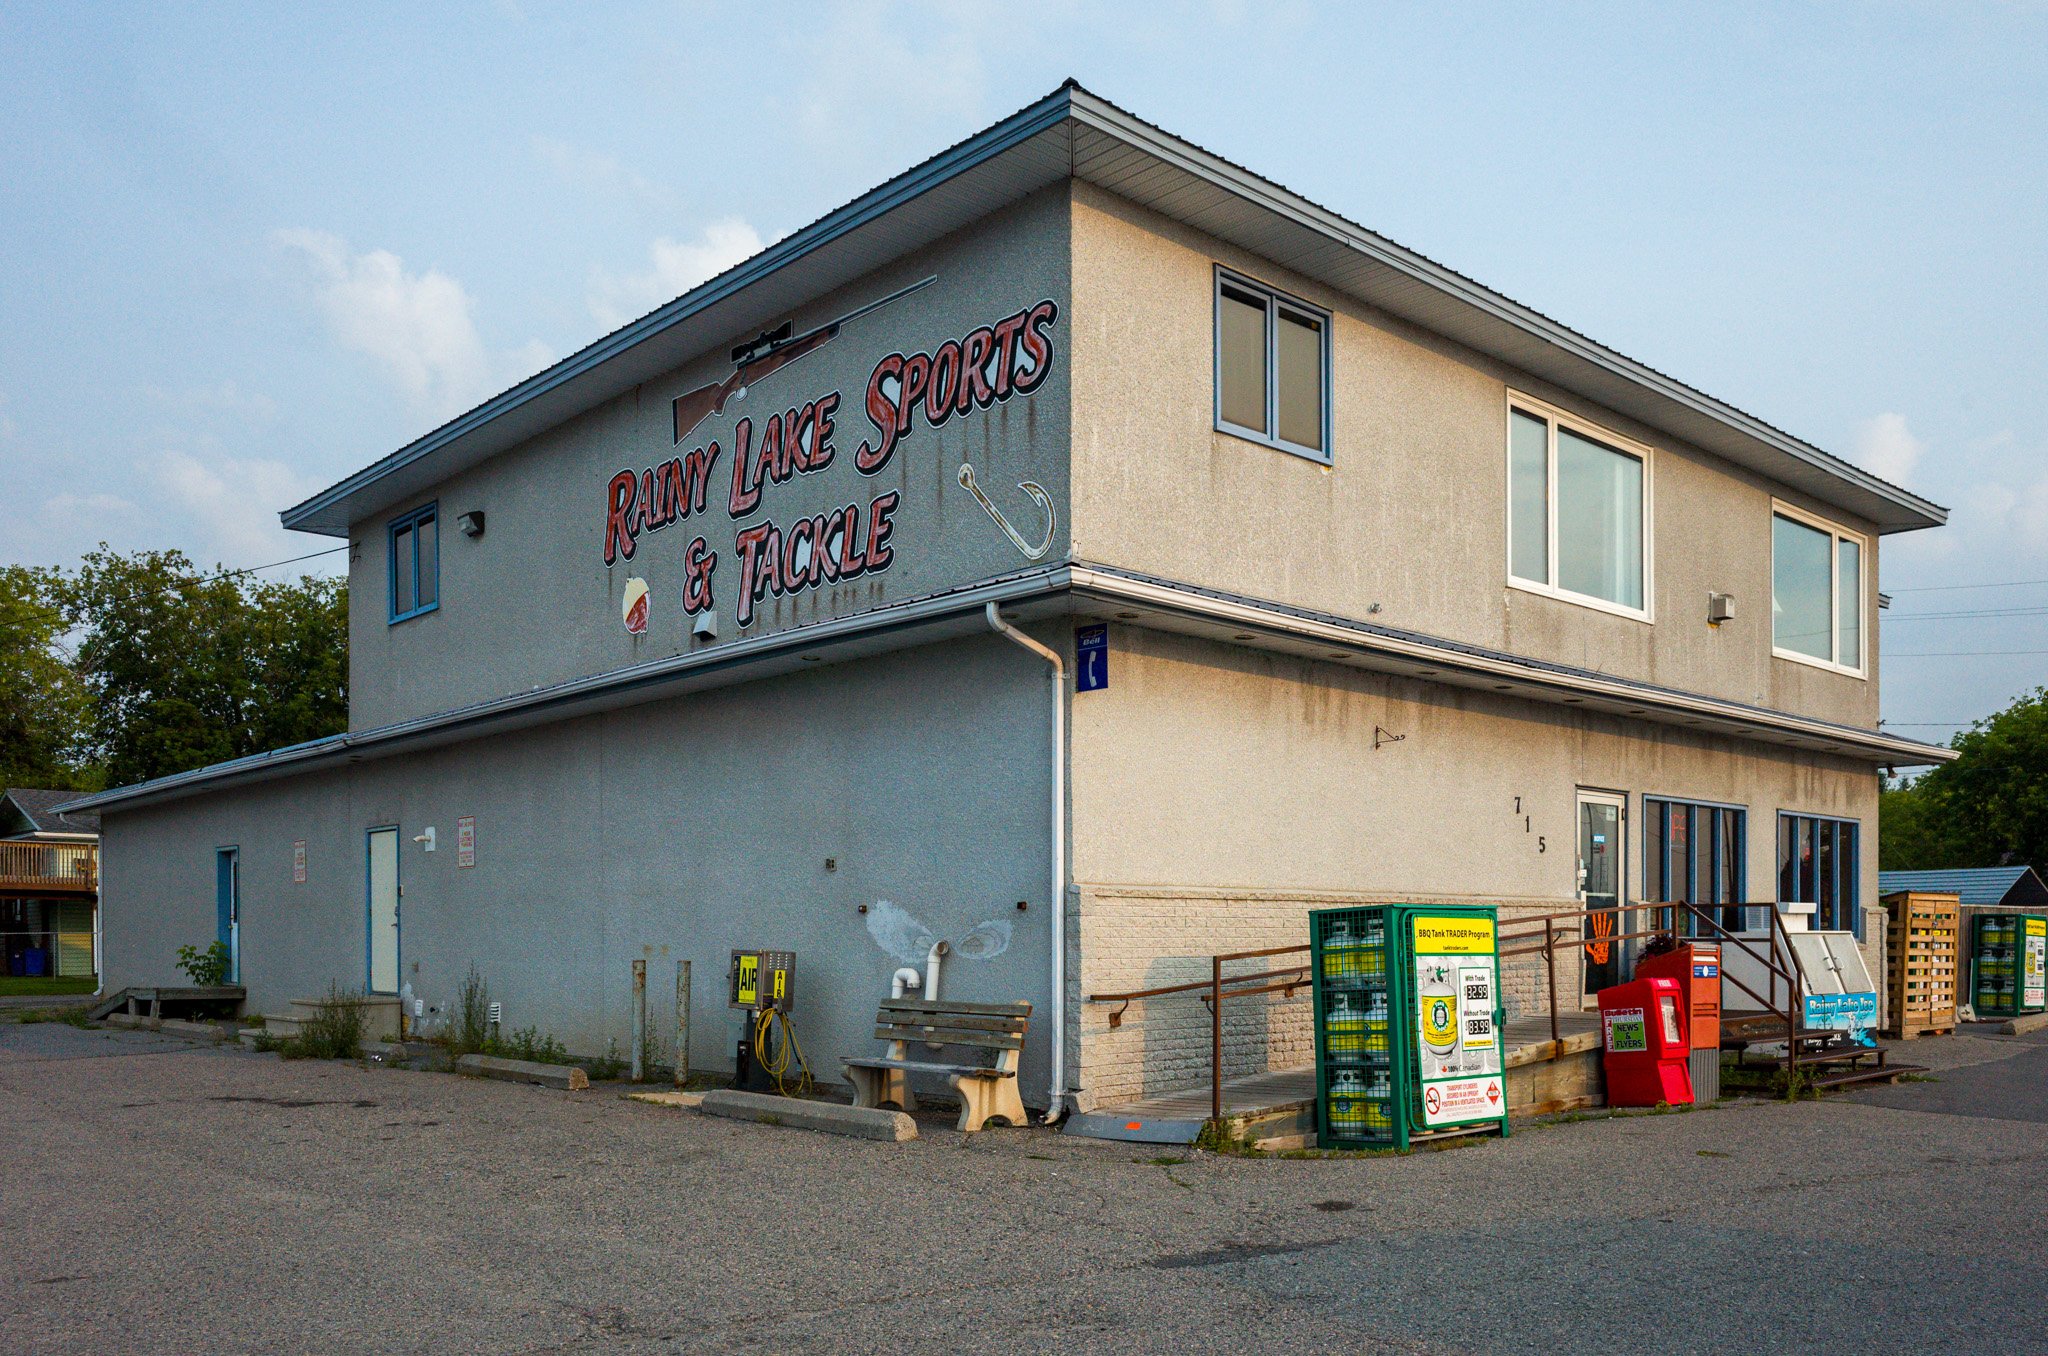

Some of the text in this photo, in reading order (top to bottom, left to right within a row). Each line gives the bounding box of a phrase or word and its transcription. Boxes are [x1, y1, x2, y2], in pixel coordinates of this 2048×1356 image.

[604, 299, 1060, 567] RAINY LAKE SPORTS
[682, 490, 900, 629] & TACKLE
[1083, 637, 1100, 646] Bell
[1418, 929, 1490, 940] BBQ Tank TRADER Program
[740, 967, 757, 991] AIR
[1605, 1008, 1642, 1016] Bulletin
[1809, 997, 1874, 1018] Rainy Lake Ice
[1605, 1019, 1614, 1052] FREE
[1625, 1032, 1631, 1040] &
[1616, 1040, 1643, 1048] FLYERS
